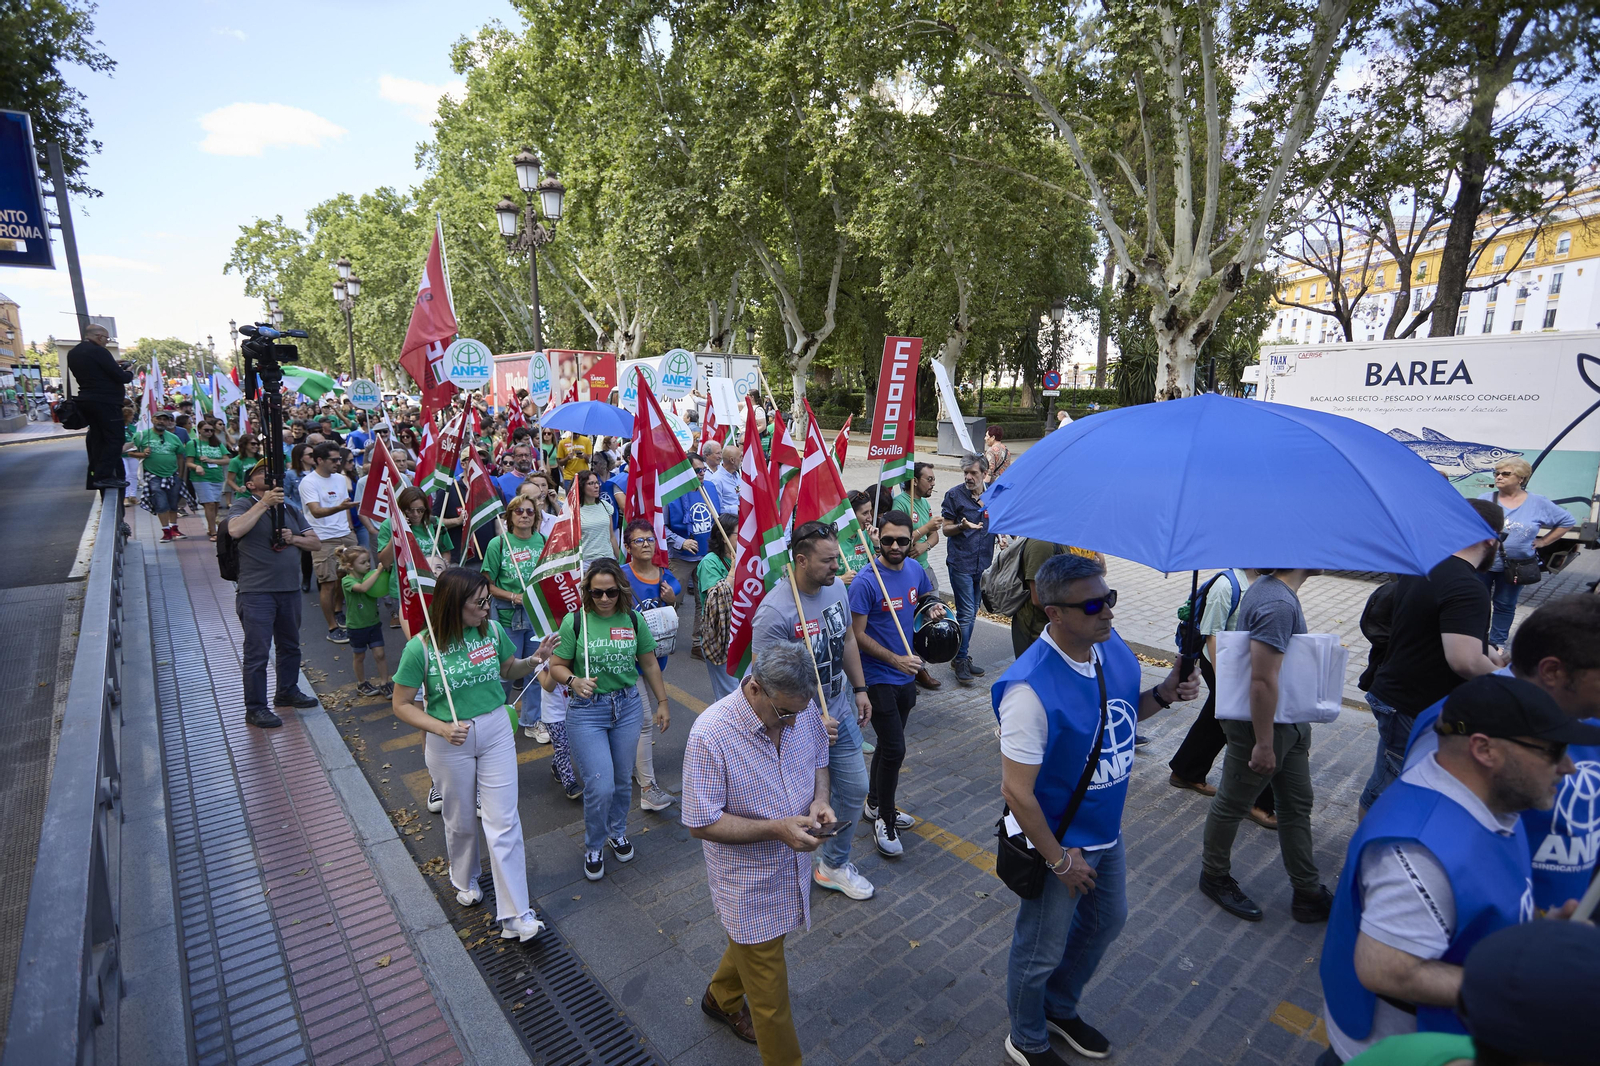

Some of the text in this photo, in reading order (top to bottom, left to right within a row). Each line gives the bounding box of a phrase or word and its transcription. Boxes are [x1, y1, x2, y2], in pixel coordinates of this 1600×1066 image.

[1270, 356, 1288, 365] FNAX
[450, 366, 488, 376] ANPE
[1365, 358, 1474, 386] BAREA
[662, 374, 692, 386] ANPE
[884, 341, 912, 421] CCOO
[532, 380, 549, 393] ANPE
[1374, 406, 1413, 414] seguimos
[870, 444, 903, 456] Sevilla
[554, 573, 578, 612] evilla
